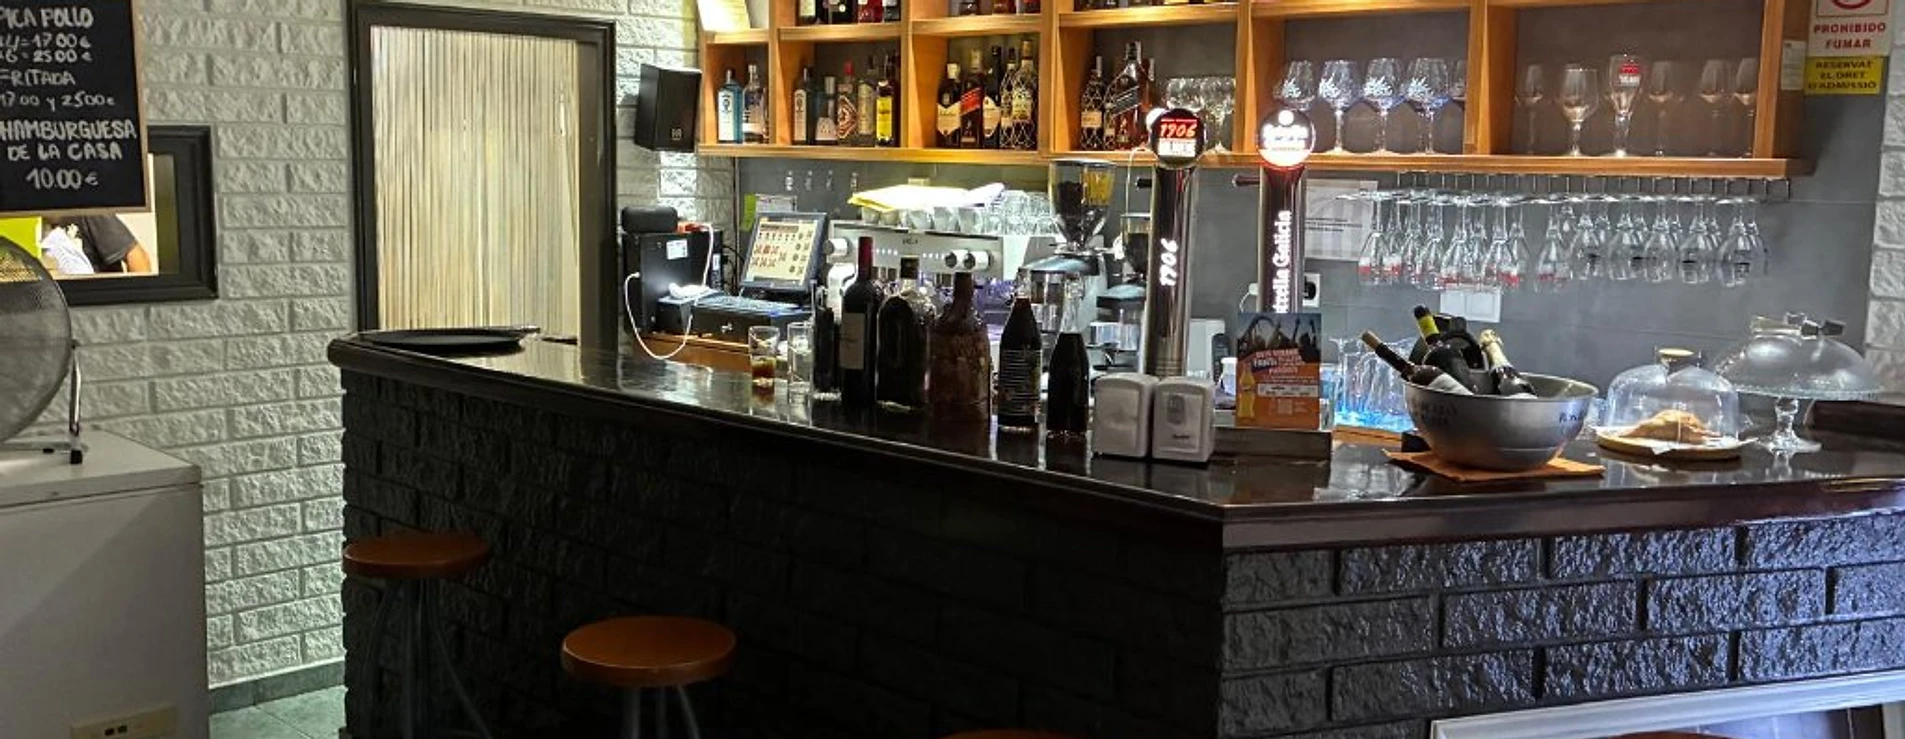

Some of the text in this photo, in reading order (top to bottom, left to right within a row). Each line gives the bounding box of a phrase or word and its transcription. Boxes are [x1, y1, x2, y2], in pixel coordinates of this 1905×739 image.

[40, 6, 94, 28] POLLO
[1814, 22, 1886, 34] PROHIBIDO
[1825, 39, 1871, 48] FUMAR
[0, 119, 137, 140] HAMBURGUESA
[1160, 122, 1198, 138] 1906
[7, 141, 123, 161] DE LA CASA
[1160, 238, 1179, 287] 1906
